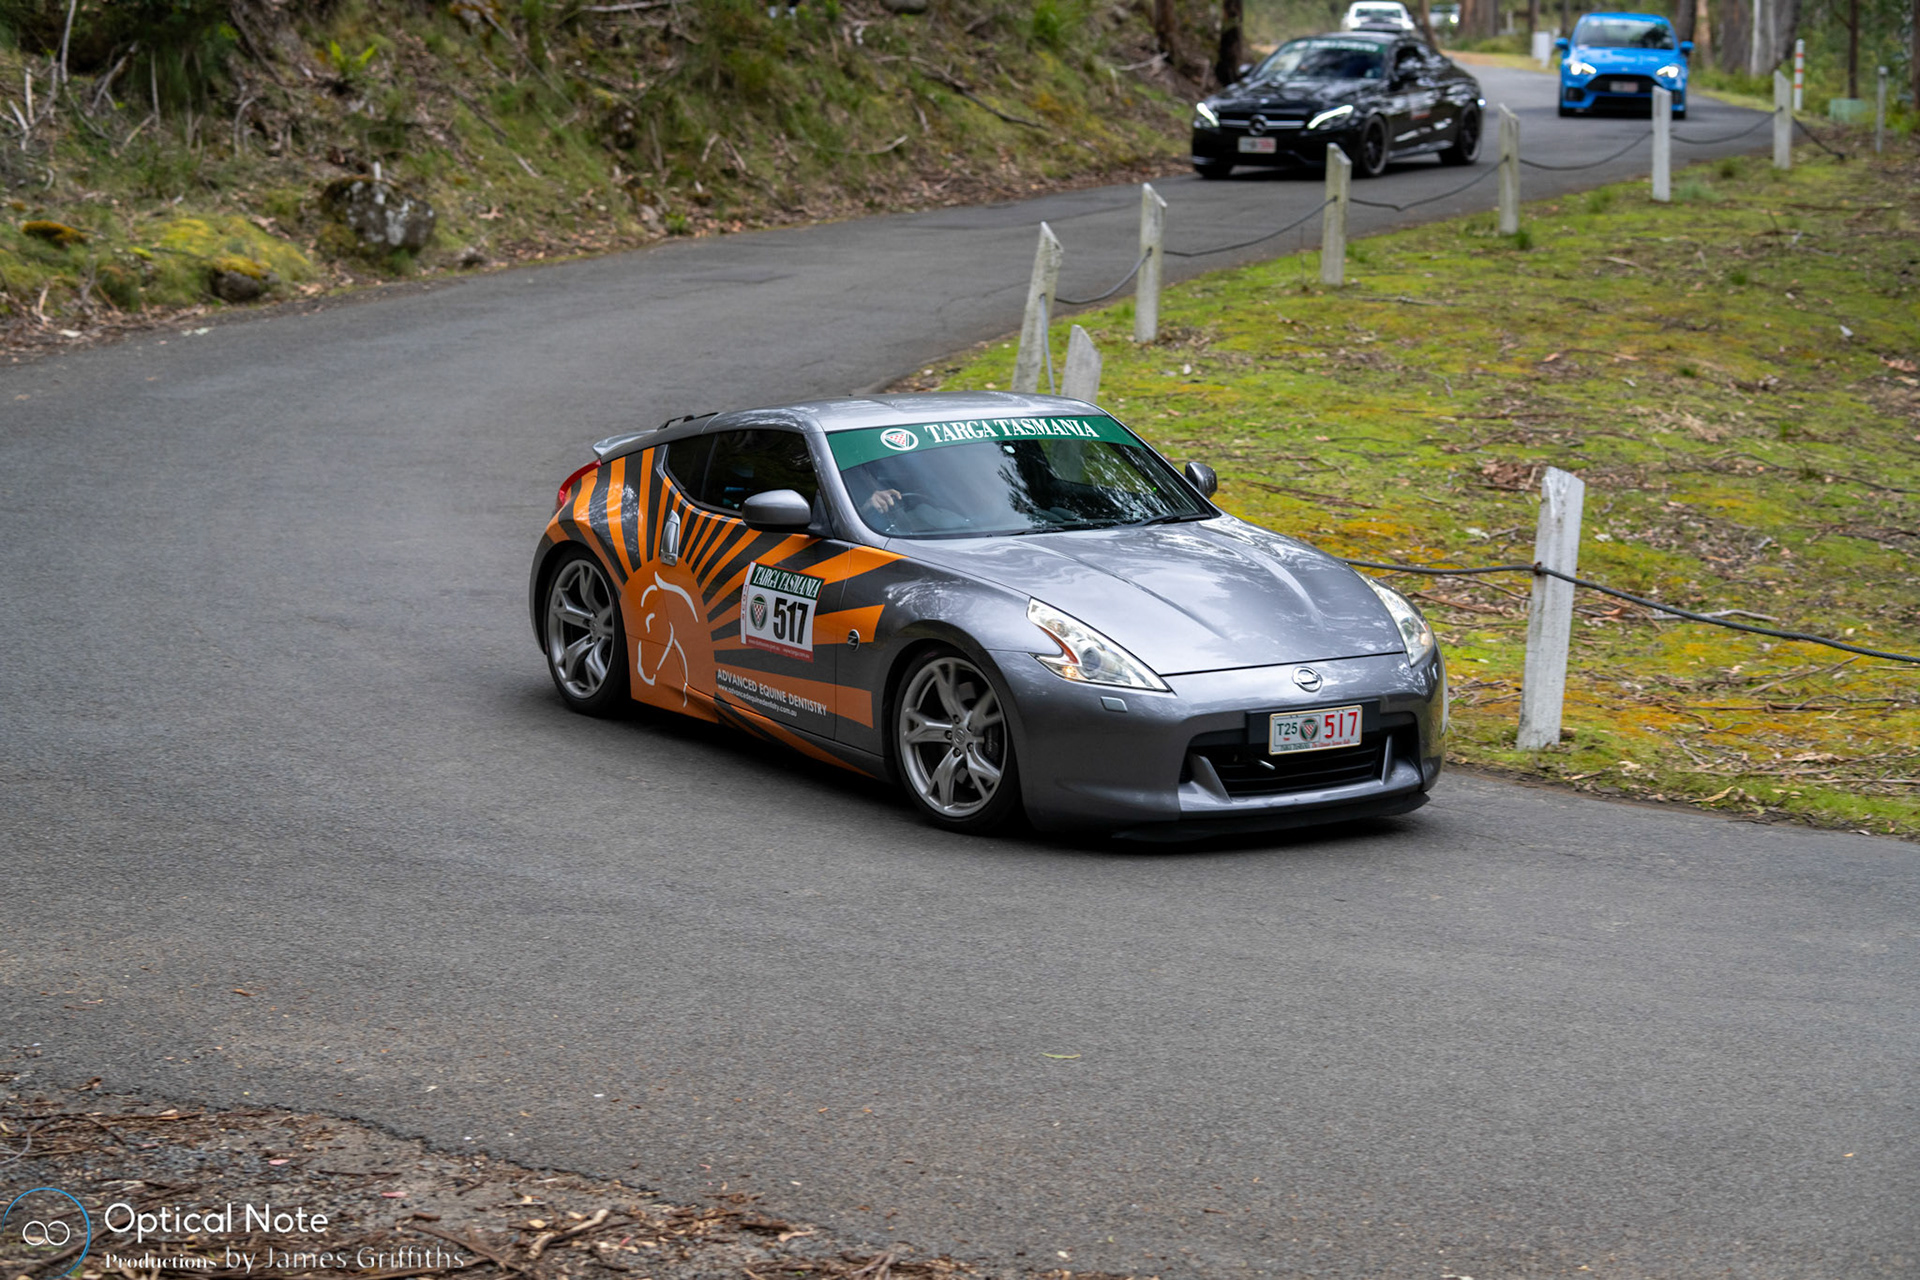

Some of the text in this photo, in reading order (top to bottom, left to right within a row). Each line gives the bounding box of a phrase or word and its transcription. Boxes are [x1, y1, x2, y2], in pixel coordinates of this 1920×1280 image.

[924, 418, 1100, 443] TARGA TASMANIA
[753, 566, 822, 599] TARGA TASMANIA
[773, 597, 809, 645] 517
[717, 668, 827, 717] ADVANCED EQUINE DENTISTRY
[717, 683, 798, 717] www.advancedequinedentistry.com.au
[1276, 711, 1358, 739] T25 517
